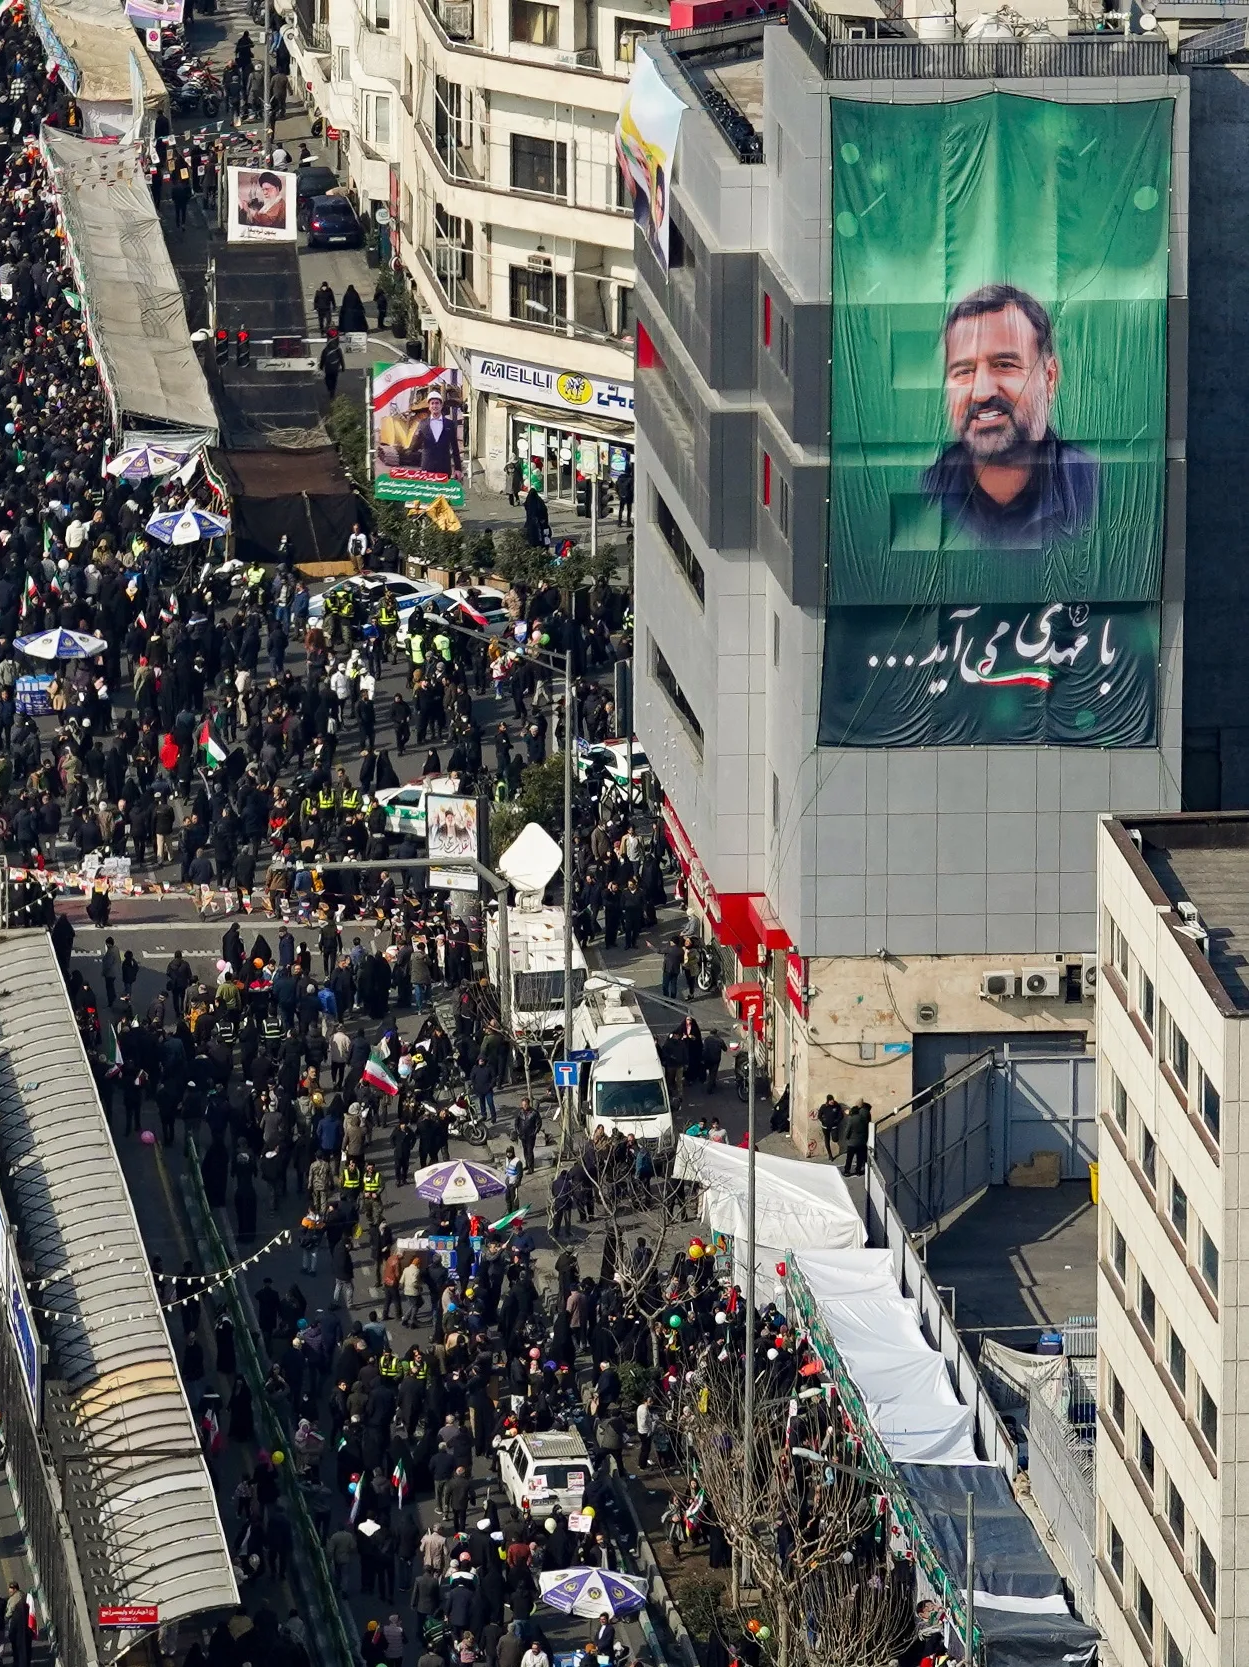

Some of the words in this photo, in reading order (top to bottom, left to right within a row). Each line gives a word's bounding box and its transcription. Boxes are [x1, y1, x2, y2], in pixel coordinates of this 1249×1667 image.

[480, 360, 553, 389] MELLI
[597, 384, 627, 408] ملی
[1016, 603, 1089, 667] مهدی
[1100, 618, 1116, 696] با
